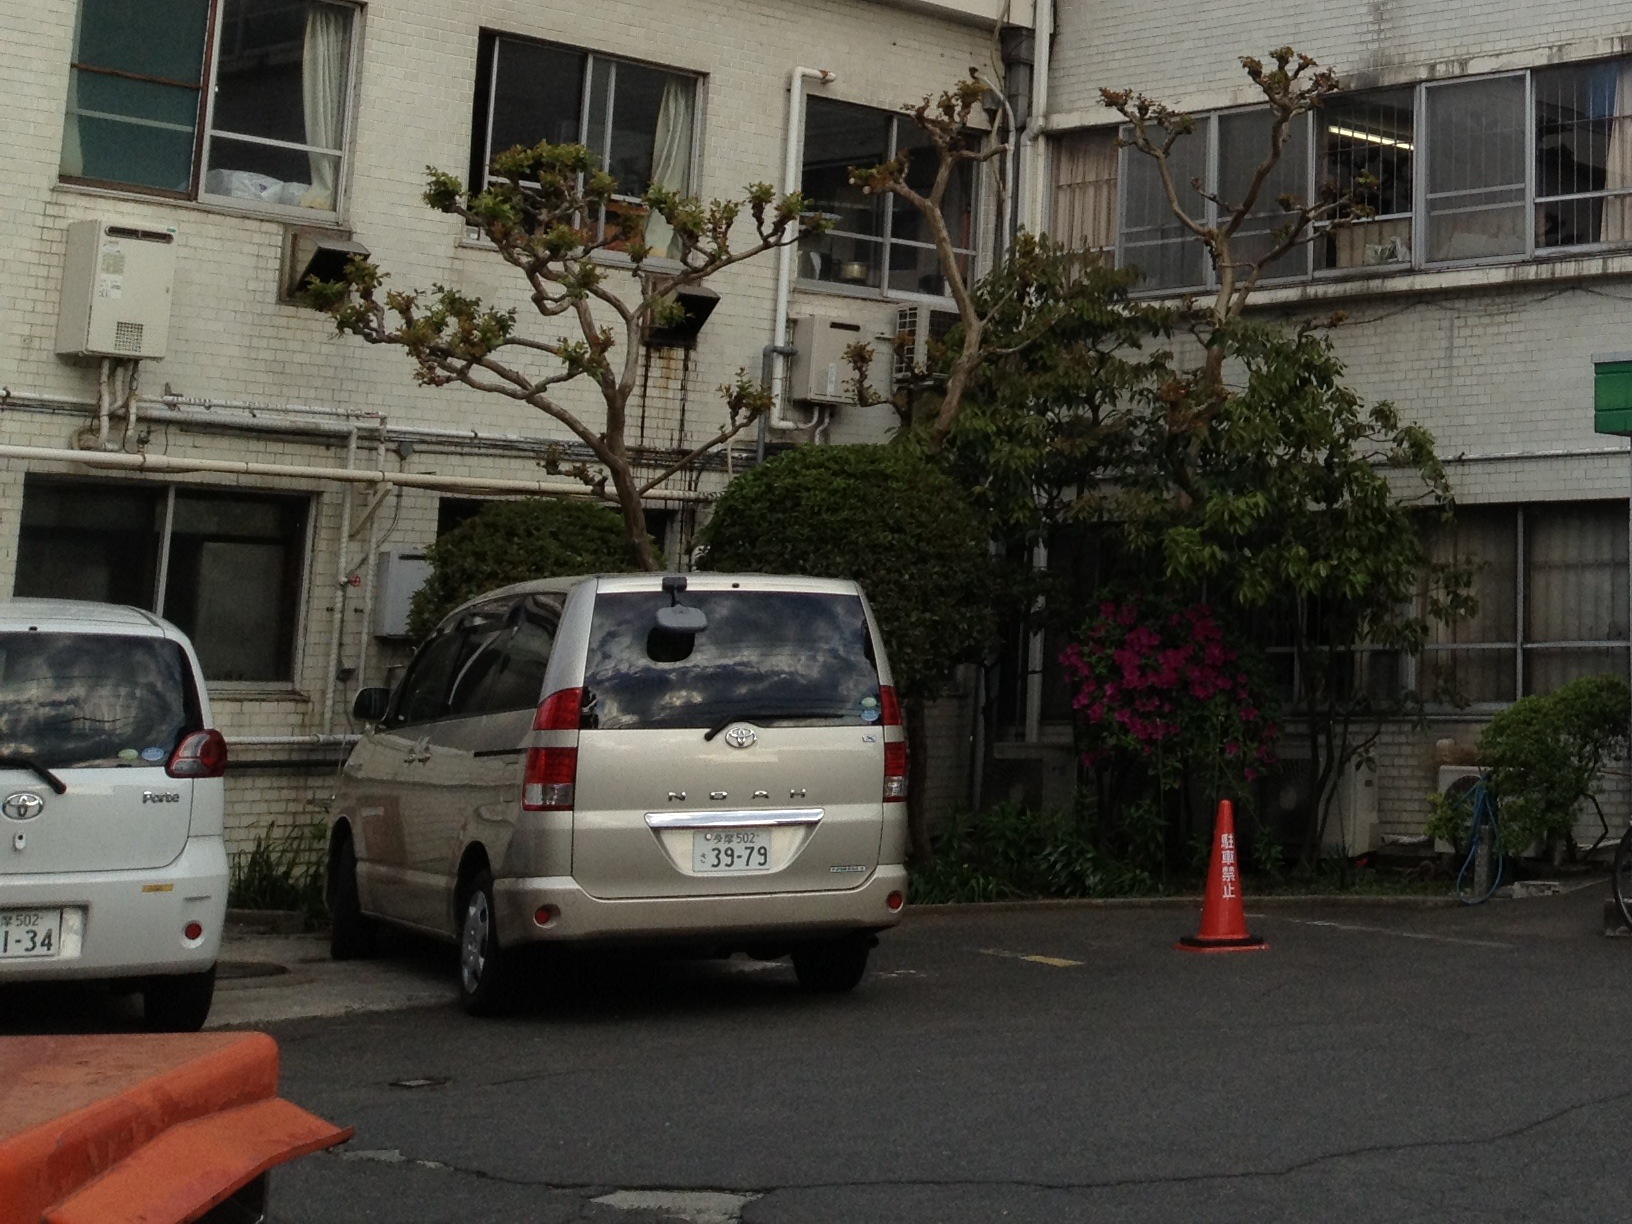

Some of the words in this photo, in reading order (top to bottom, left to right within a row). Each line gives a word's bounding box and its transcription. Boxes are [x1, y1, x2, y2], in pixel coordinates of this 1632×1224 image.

[142, 790, 180, 804] Porte
[667, 788, 807, 802] NOAH
[736, 832, 756, 844] 502
[711, 845, 768, 868] 39-79
[1221, 833, 1236, 900] 駐車禁止
[15, 914, 40, 927] 502
[2, 928, 53, 954] 1-34
